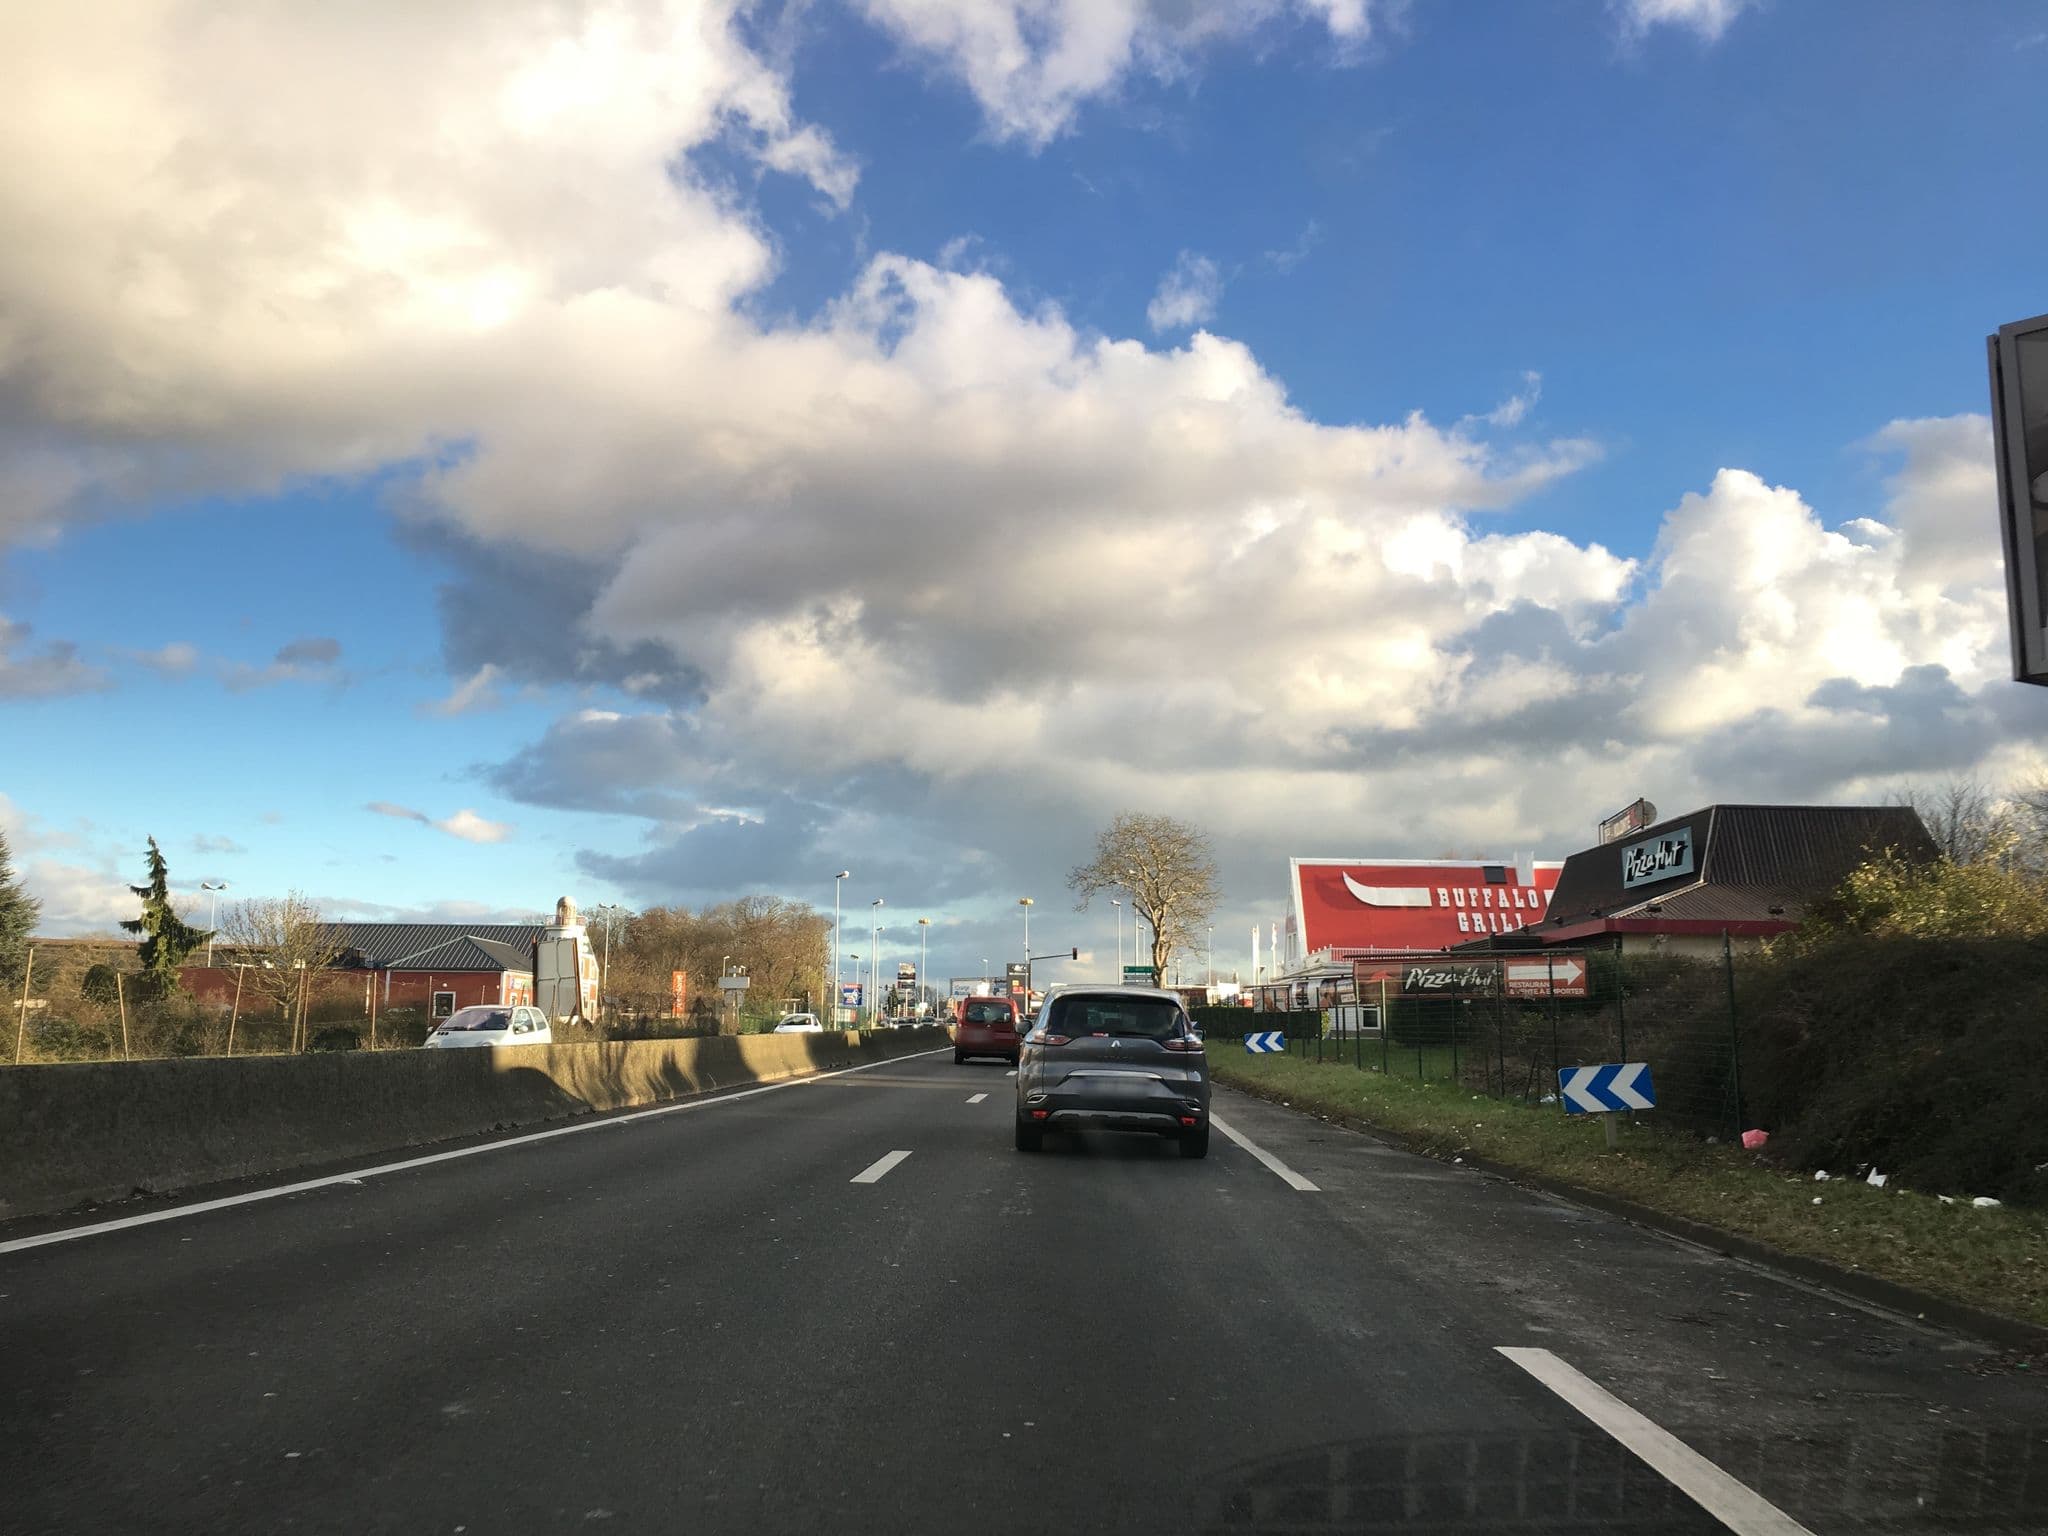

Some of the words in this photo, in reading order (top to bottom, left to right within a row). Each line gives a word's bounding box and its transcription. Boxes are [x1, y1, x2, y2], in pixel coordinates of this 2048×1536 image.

[1624, 847, 1655, 882] Pizza
[1654, 841, 1684, 870] Hut
[1436, 887, 1539, 909] BUFFALO
[1457, 912, 1523, 933] GRILL
[1405, 967, 1458, 990] Pizza
[1508, 981, 1554, 989] RESTAURAN
